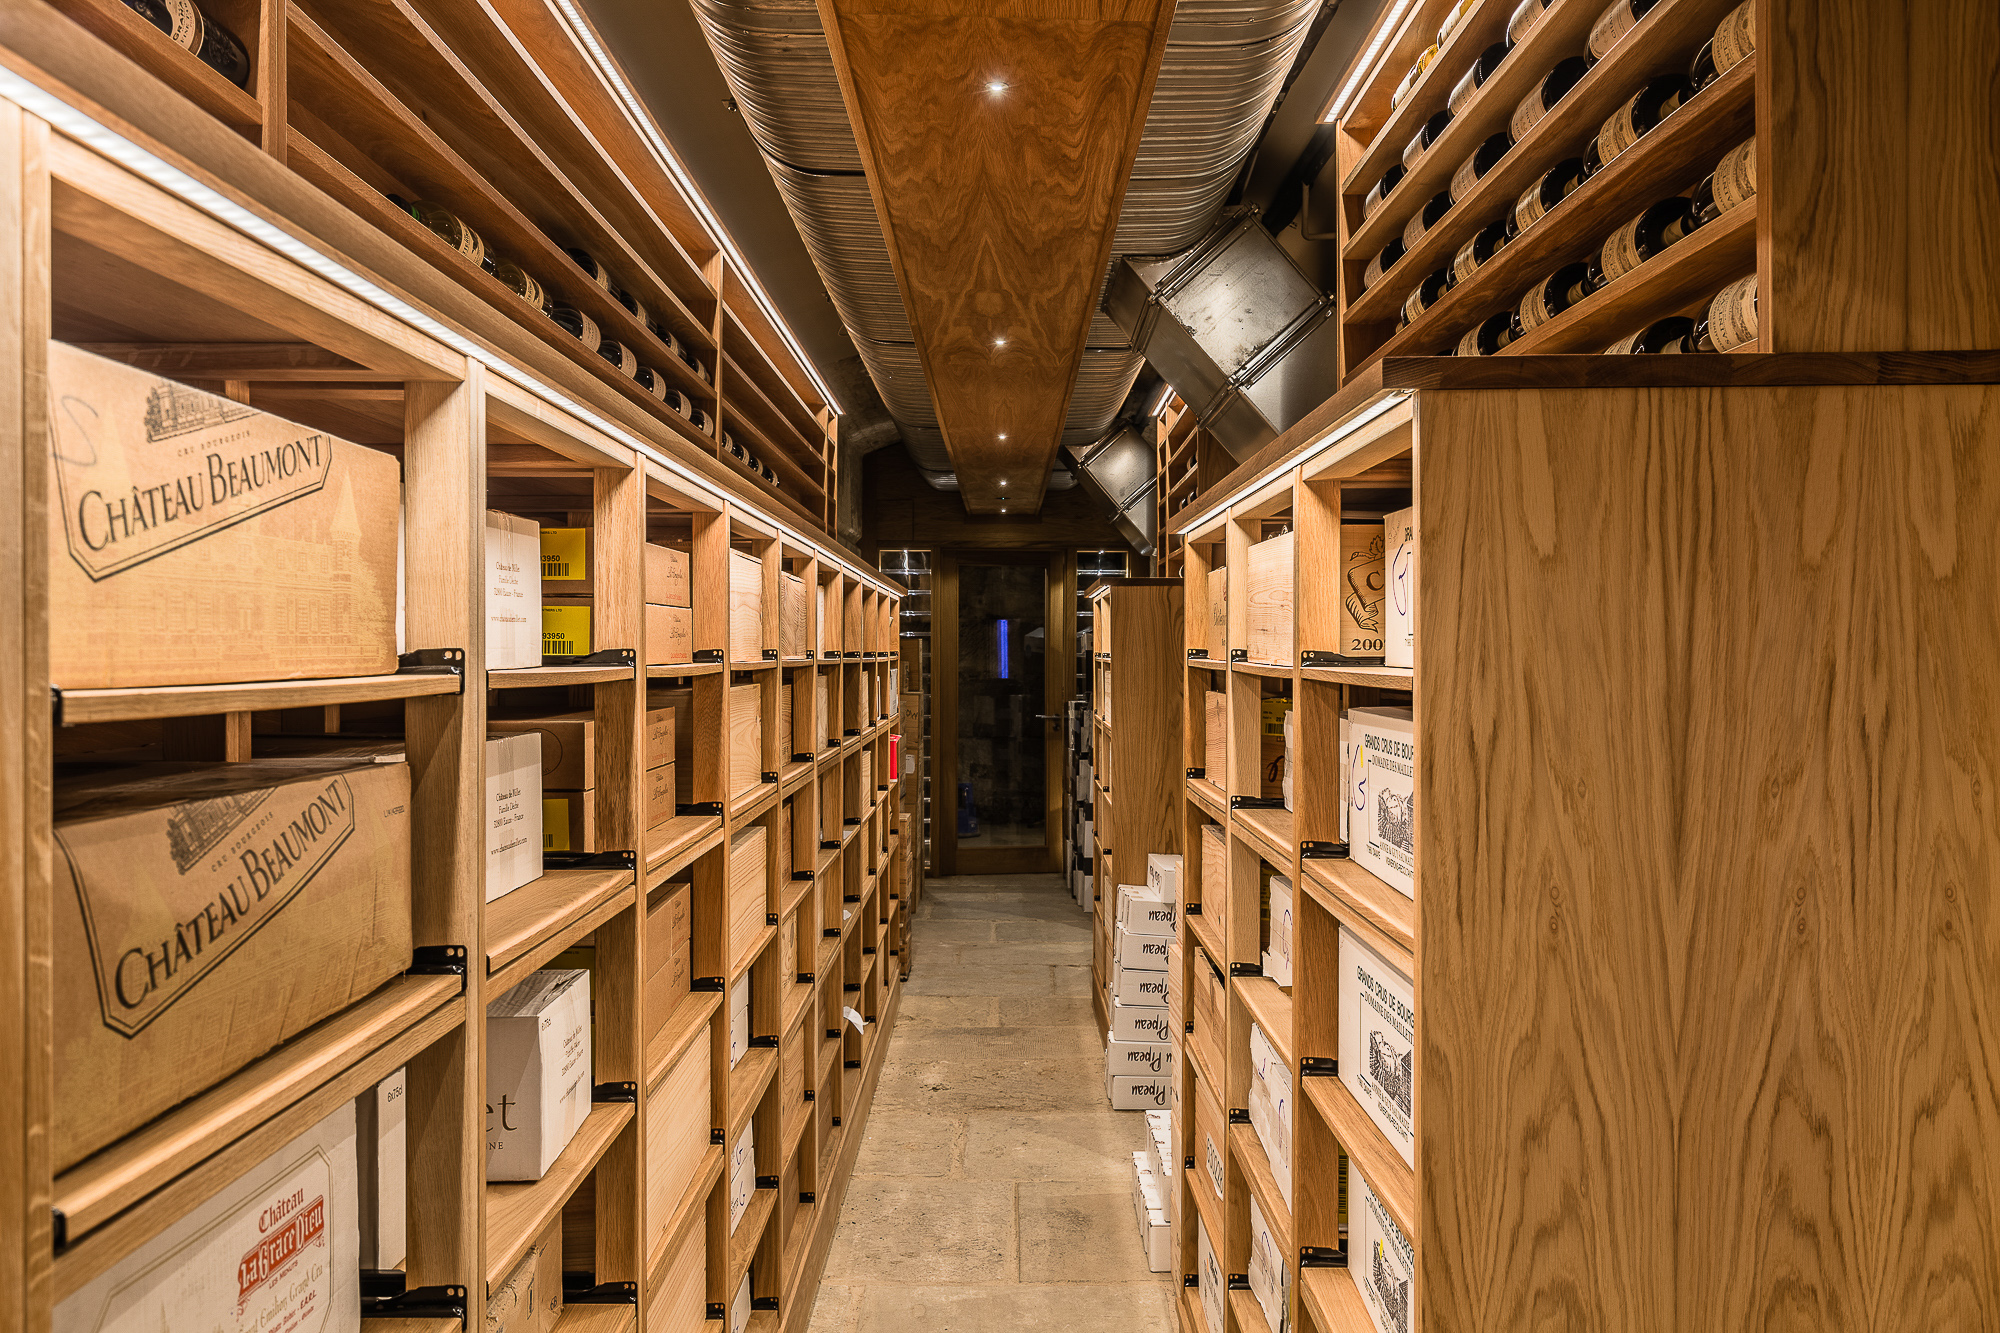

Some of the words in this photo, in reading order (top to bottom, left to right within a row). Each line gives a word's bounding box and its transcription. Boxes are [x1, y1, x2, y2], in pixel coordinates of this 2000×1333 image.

[78, 472, 205, 552] CHÂTEAU
[205, 434, 323, 506] BEAUMONT
[542, 632, 565, 640] 93950
[1351, 638, 1385, 651] 200
[1393, 740, 1401, 758] DE
[230, 810, 275, 851] BOURGEOIS
[115, 876, 250, 1009] CHÂTEAU
[239, 779, 347, 902] BEAUMONT
[1388, 992, 1396, 1012] DE
[1134, 1014, 1169, 1040] Pipeau
[1127, 1046, 1161, 1072] Pipeau
[1131, 1079, 1166, 1106] Pipeau
[258, 1188, 304, 1234] Château
[240, 1258, 258, 1290] La
